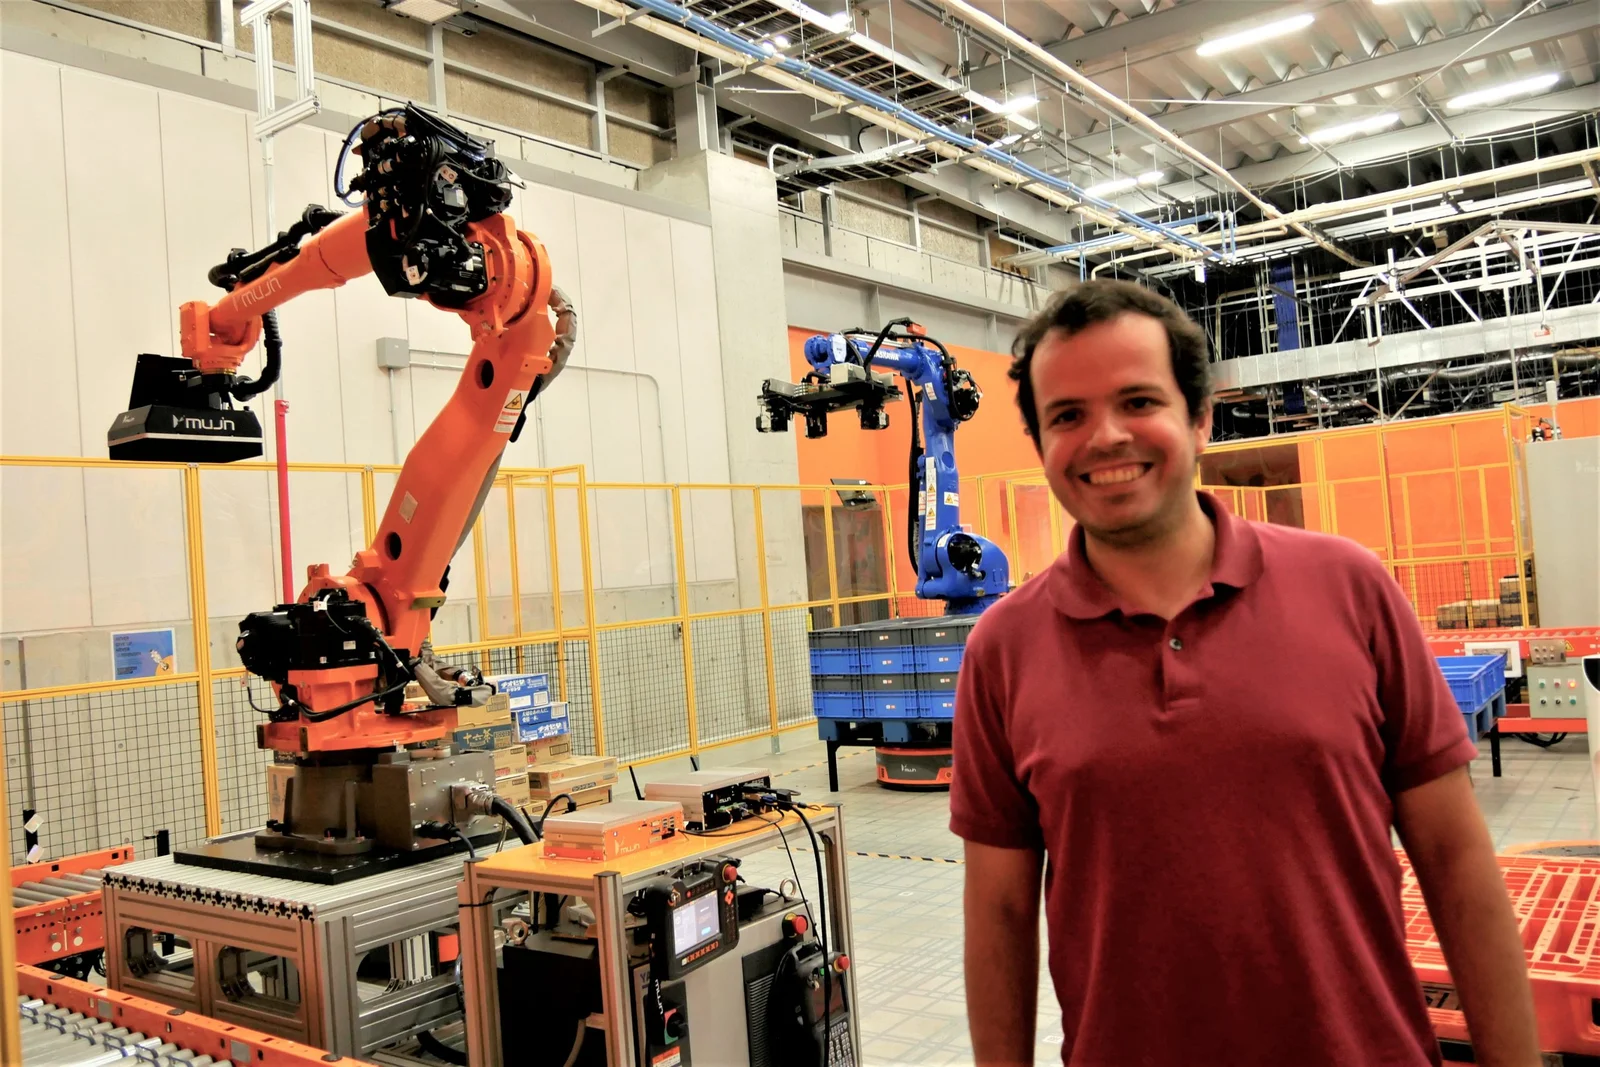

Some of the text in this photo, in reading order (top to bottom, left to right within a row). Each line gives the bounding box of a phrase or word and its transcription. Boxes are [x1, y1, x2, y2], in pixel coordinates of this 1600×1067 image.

[873, 350, 899, 361] ASKAWA
[463, 728, 493, 745] 十六茶
